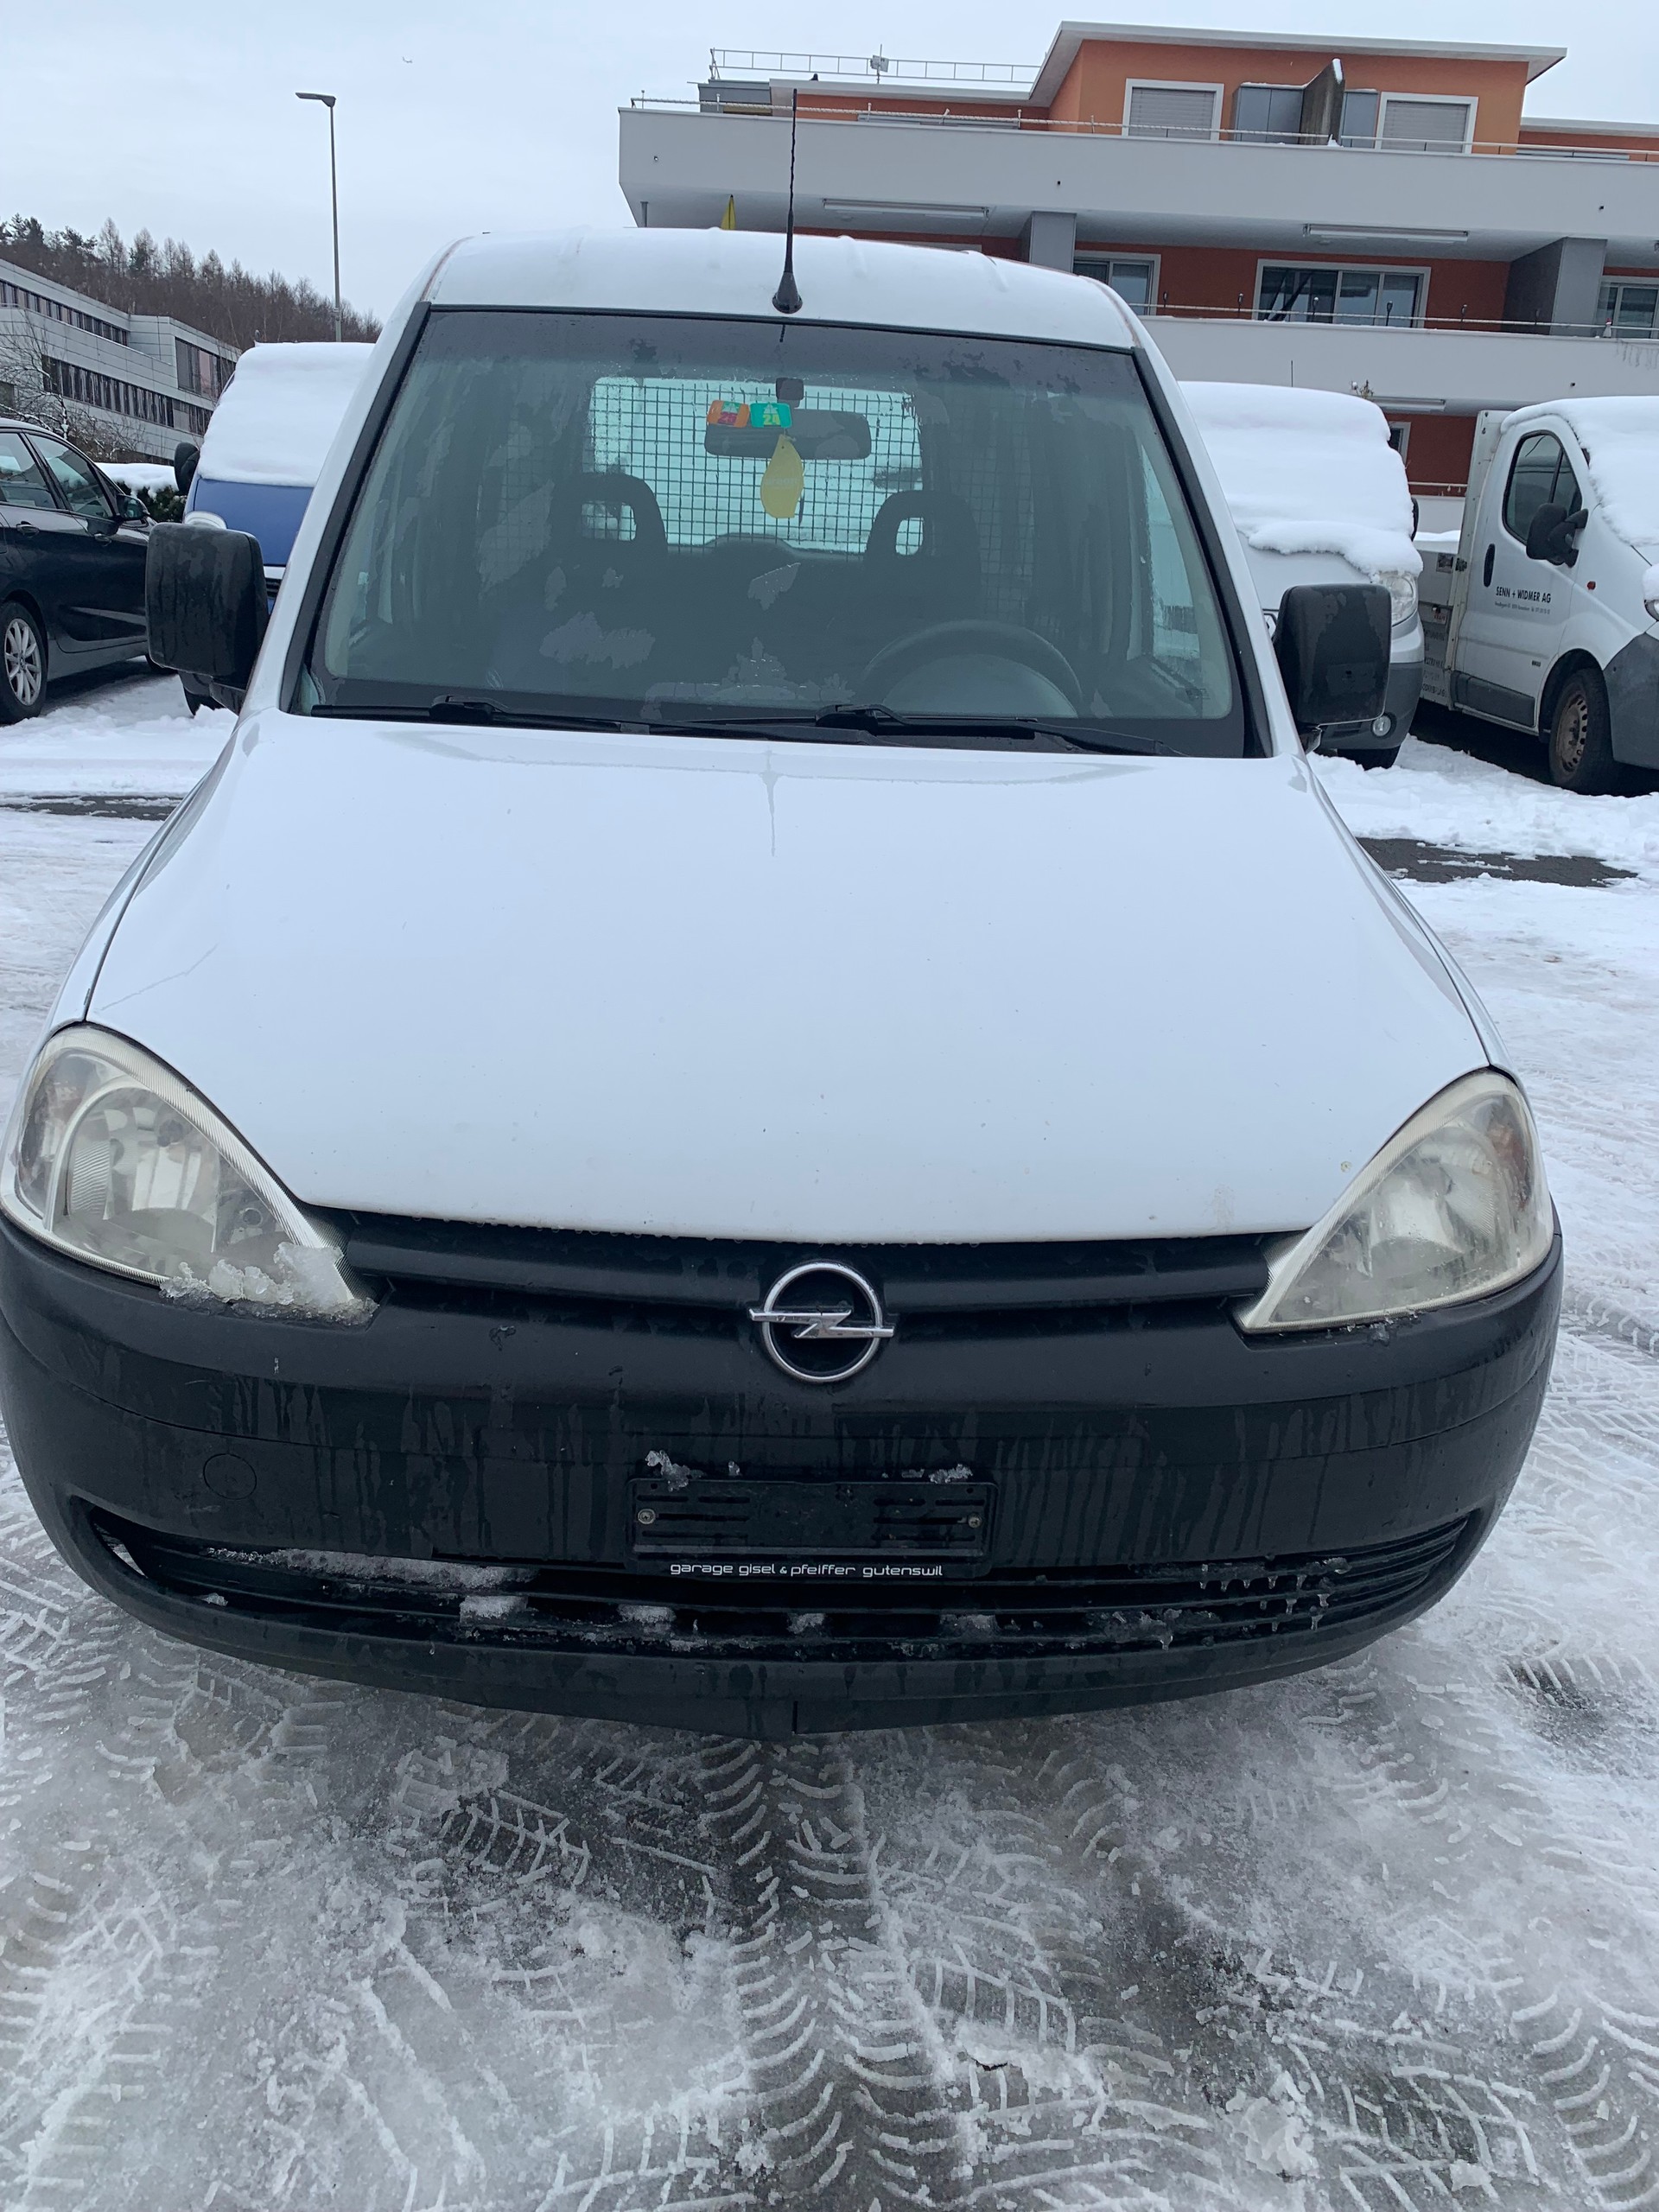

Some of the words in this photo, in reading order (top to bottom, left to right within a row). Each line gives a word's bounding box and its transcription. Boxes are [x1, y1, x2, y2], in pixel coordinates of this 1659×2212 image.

[763, 414, 781, 425] 24
[1496, 586, 1510, 598] SENN
[1517, 589, 1540, 602] WIDMER
[1541, 593, 1552, 604] AG
[670, 1563, 734, 1576] garage
[739, 1563, 775, 1576] gisel
[779, 1566, 787, 1574] &
[791, 1564, 856, 1577] pfeiffer
[862, 1565, 943, 1578] gutenswil
